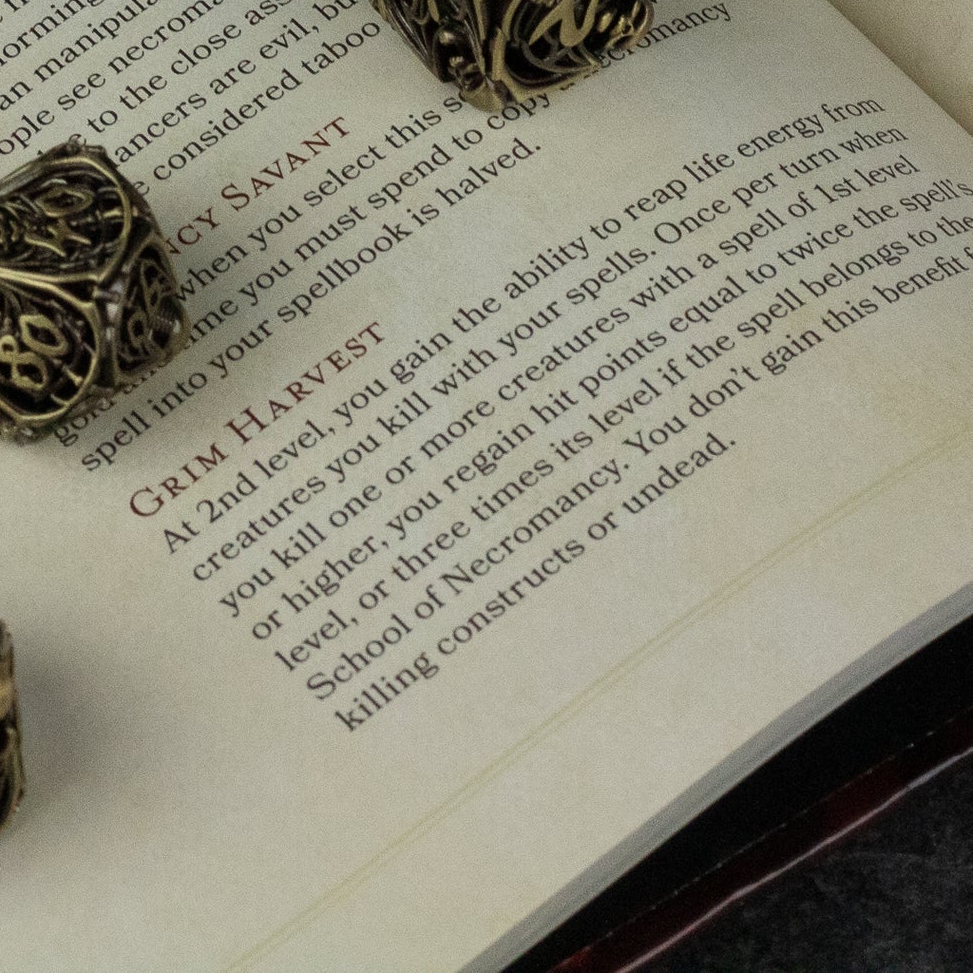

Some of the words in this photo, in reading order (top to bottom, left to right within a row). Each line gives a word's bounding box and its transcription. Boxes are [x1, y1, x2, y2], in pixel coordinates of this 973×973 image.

[81, 410, 152, 472] spell
[151, 372, 208, 419] into
[208, 319, 272, 379] your
[277, 223, 412, 323] spellbook
[411, 204, 440, 227] is
[435, 137, 541, 207] halved.
[220, 116, 349, 212] SAVANT
[129, 442, 228, 518] GRIM
[225, 321, 384, 445] HARVEST
[163, 521, 199, 554] At
[196, 471, 258, 524] 2nd
[253, 419, 335, 479] level,
[333, 379, 388, 427] you
[390, 332, 453, 385] gain
[452, 297, 501, 333] the
[504, 236, 589, 300] ability
[590, 218, 622, 240] to
[624, 179, 688, 221] reap
[682, 153, 735, 183] life
[737, 114, 825, 158] energy
[821, 100, 885, 123] from
[306, 613, 412, 700] School
[414, 584, 444, 619] of
[440, 459, 629, 595] Necromancy.
[623, 415, 687, 455] You
[761, 330, 823, 376] gain
[822, 298, 879, 333] this
[872, 256, 969, 304] benefit
[334, 653, 439, 731] killing
[437, 544, 585, 655] constructs
[587, 511, 617, 540] or
[622, 432, 736, 514] undead.
